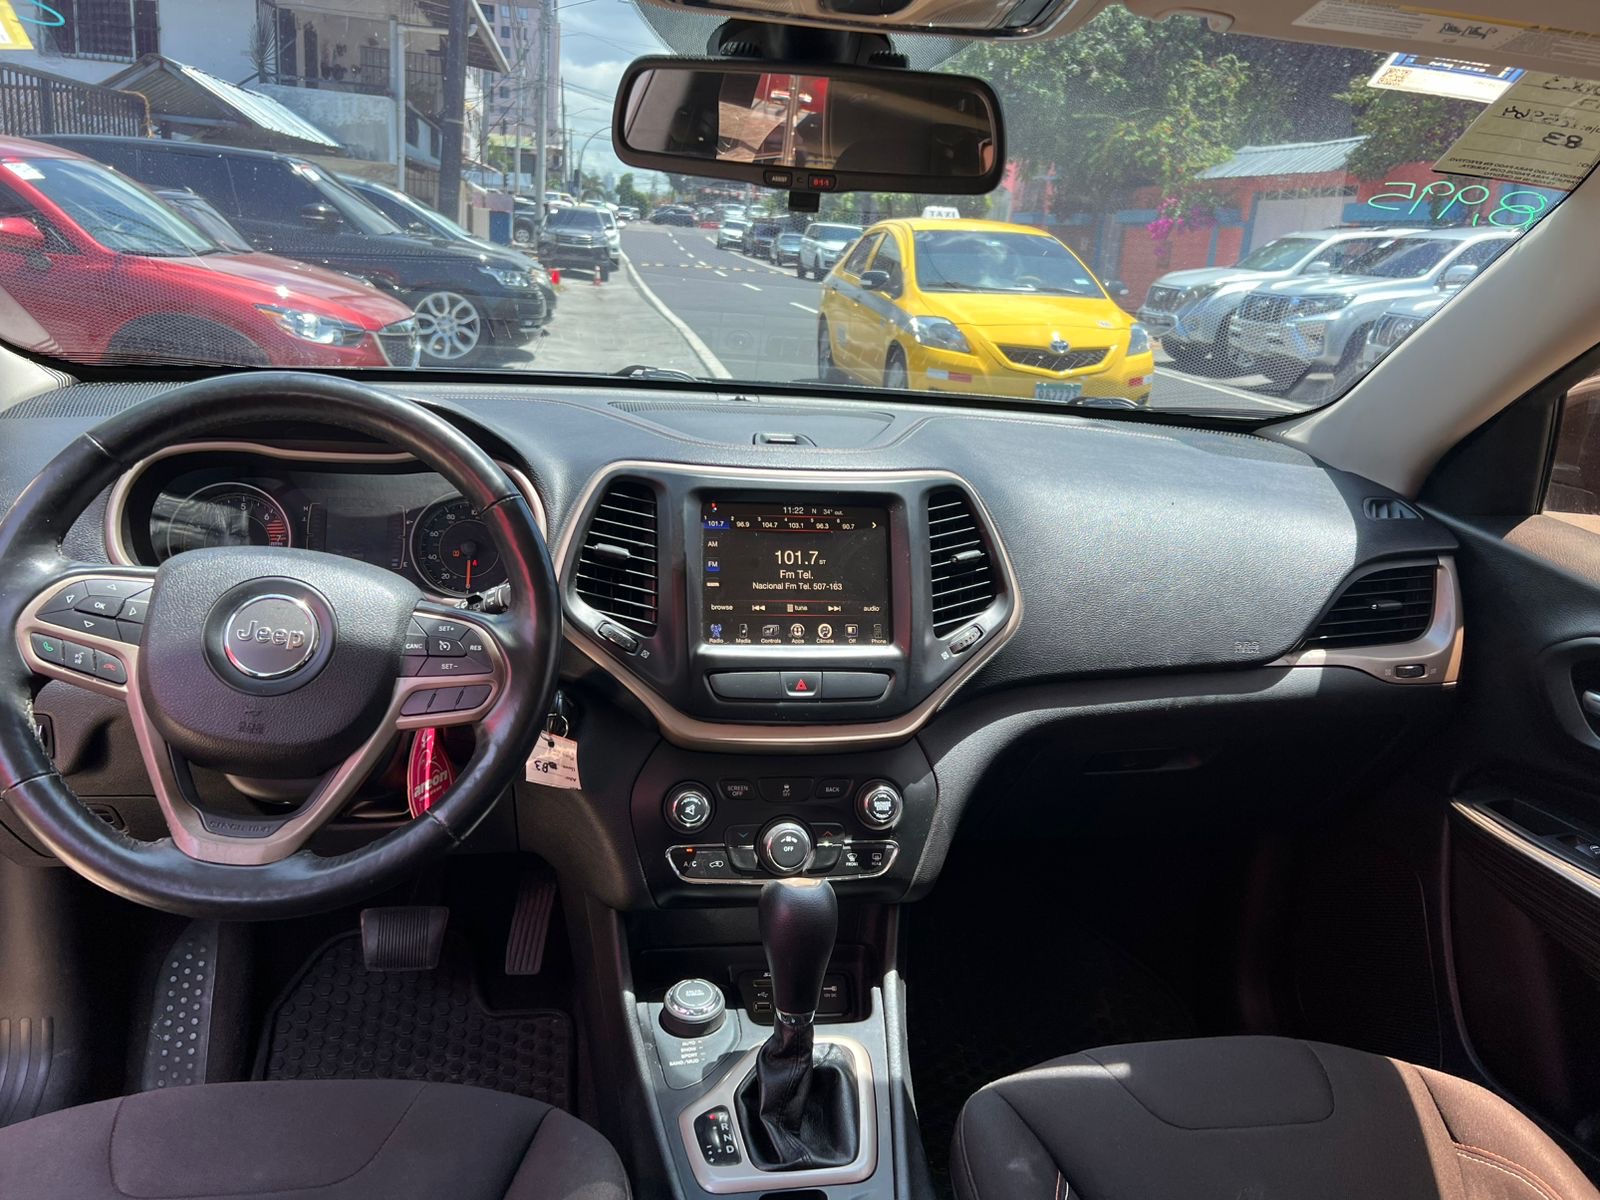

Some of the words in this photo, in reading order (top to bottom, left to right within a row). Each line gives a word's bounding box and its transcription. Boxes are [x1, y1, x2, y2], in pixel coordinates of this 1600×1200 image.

[929, 210, 956, 218] TAXI
[240, 502, 246, 510] 5
[783, 506, 804, 514] 11:22
[775, 550, 819, 565] 101.7
[780, 569, 795, 579] Fm
[797, 569, 814, 579] Tel.
[752, 581, 784, 590] Nacional
[785, 582, 797, 590] Fm
[798, 582, 812, 590] Tel.
[813, 582, 843, 590] 507-163
[94, 601, 106, 610] OK
[710, 603, 734, 611] browse
[236, 620, 306, 649] Jeep
[414, 770, 449, 798] areon
[683, 860, 697, 868] A/C
[721, 1123, 729, 1131] R
[723, 1133, 732, 1142] N
[726, 1145, 735, 1153] D
